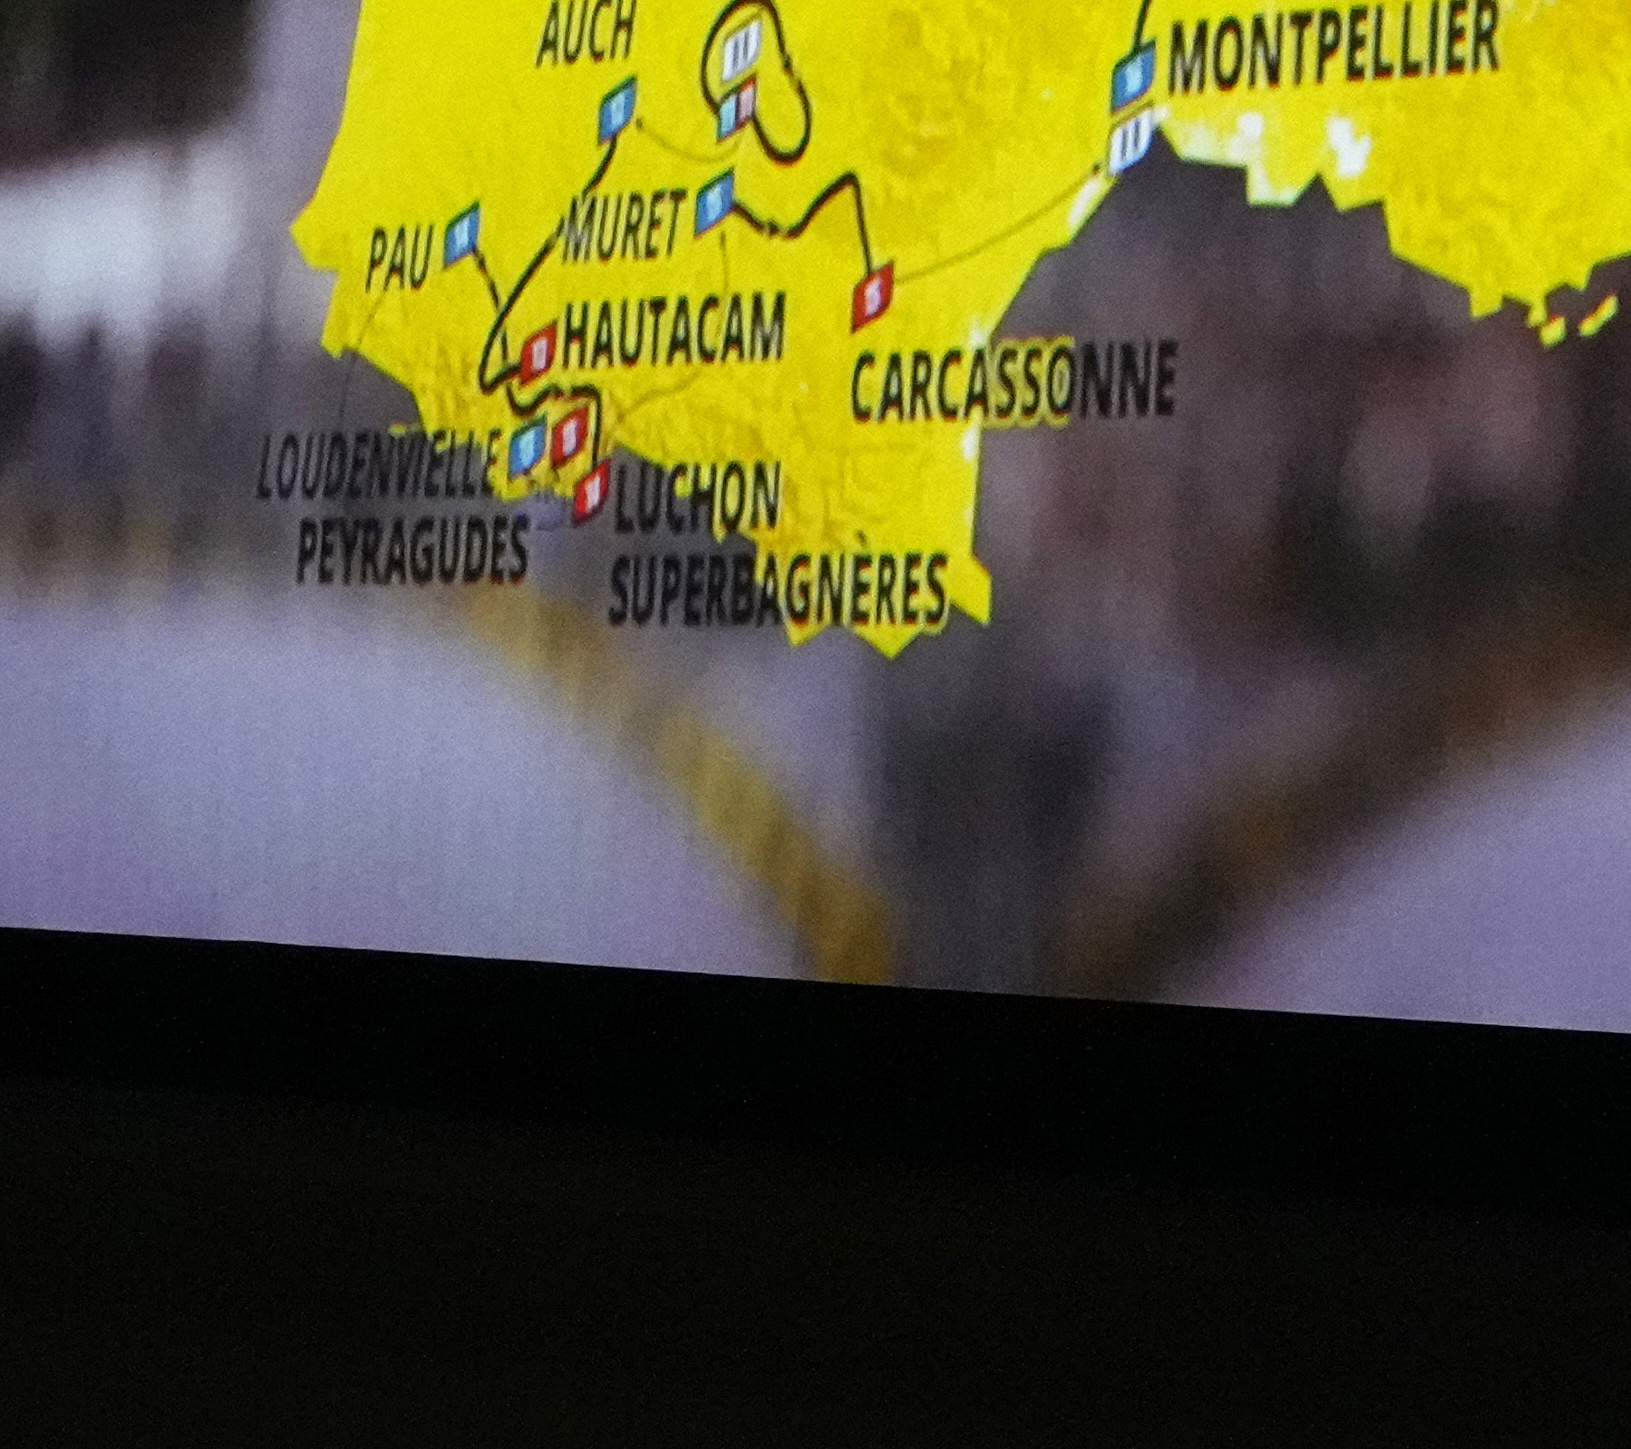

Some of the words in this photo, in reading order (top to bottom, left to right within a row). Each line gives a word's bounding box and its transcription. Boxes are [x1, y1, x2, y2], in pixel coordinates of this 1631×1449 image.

[364, 224, 436, 293] PAU
[561, 187, 690, 266] MURET
[561, 291, 787, 370] HAUTACAM
[850, 338, 1180, 424] CARCASSONNE
[255, 429, 503, 502] LOUDENVIELLE
[615, 460, 782, 536] LUCHON
[296, 512, 531, 587] PEYRAGUDES
[608, 531, 950, 627] SUPERBAGNÈRES
